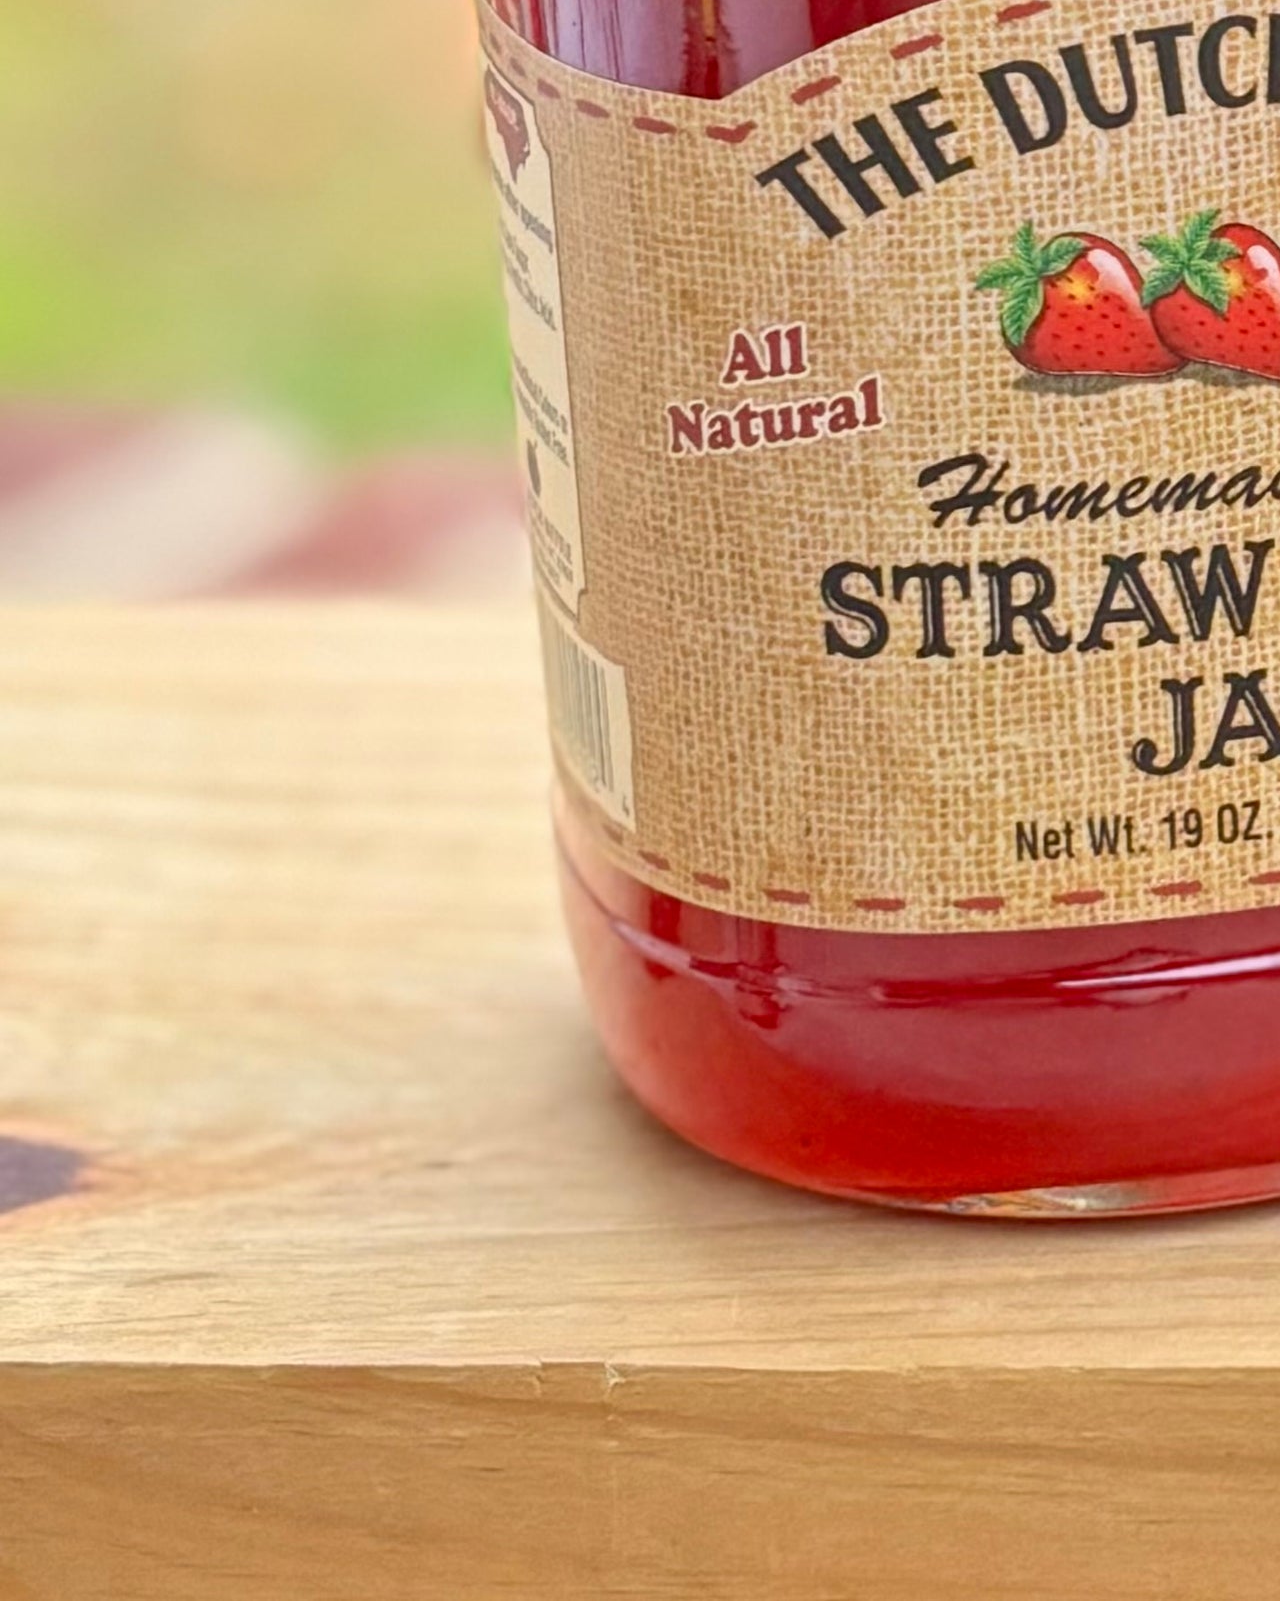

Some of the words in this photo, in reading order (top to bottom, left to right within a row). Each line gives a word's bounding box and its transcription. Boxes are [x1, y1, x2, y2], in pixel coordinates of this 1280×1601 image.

[755, 87, 977, 240] THE
[721, 326, 808, 383] All
[668, 379, 884, 454] Natural
[1016, 821, 1075, 862] Net
[1086, 815, 1147, 857] Wt.
[1161, 808, 1203, 850] 19
[1216, 799, 1274, 845] OZ.
